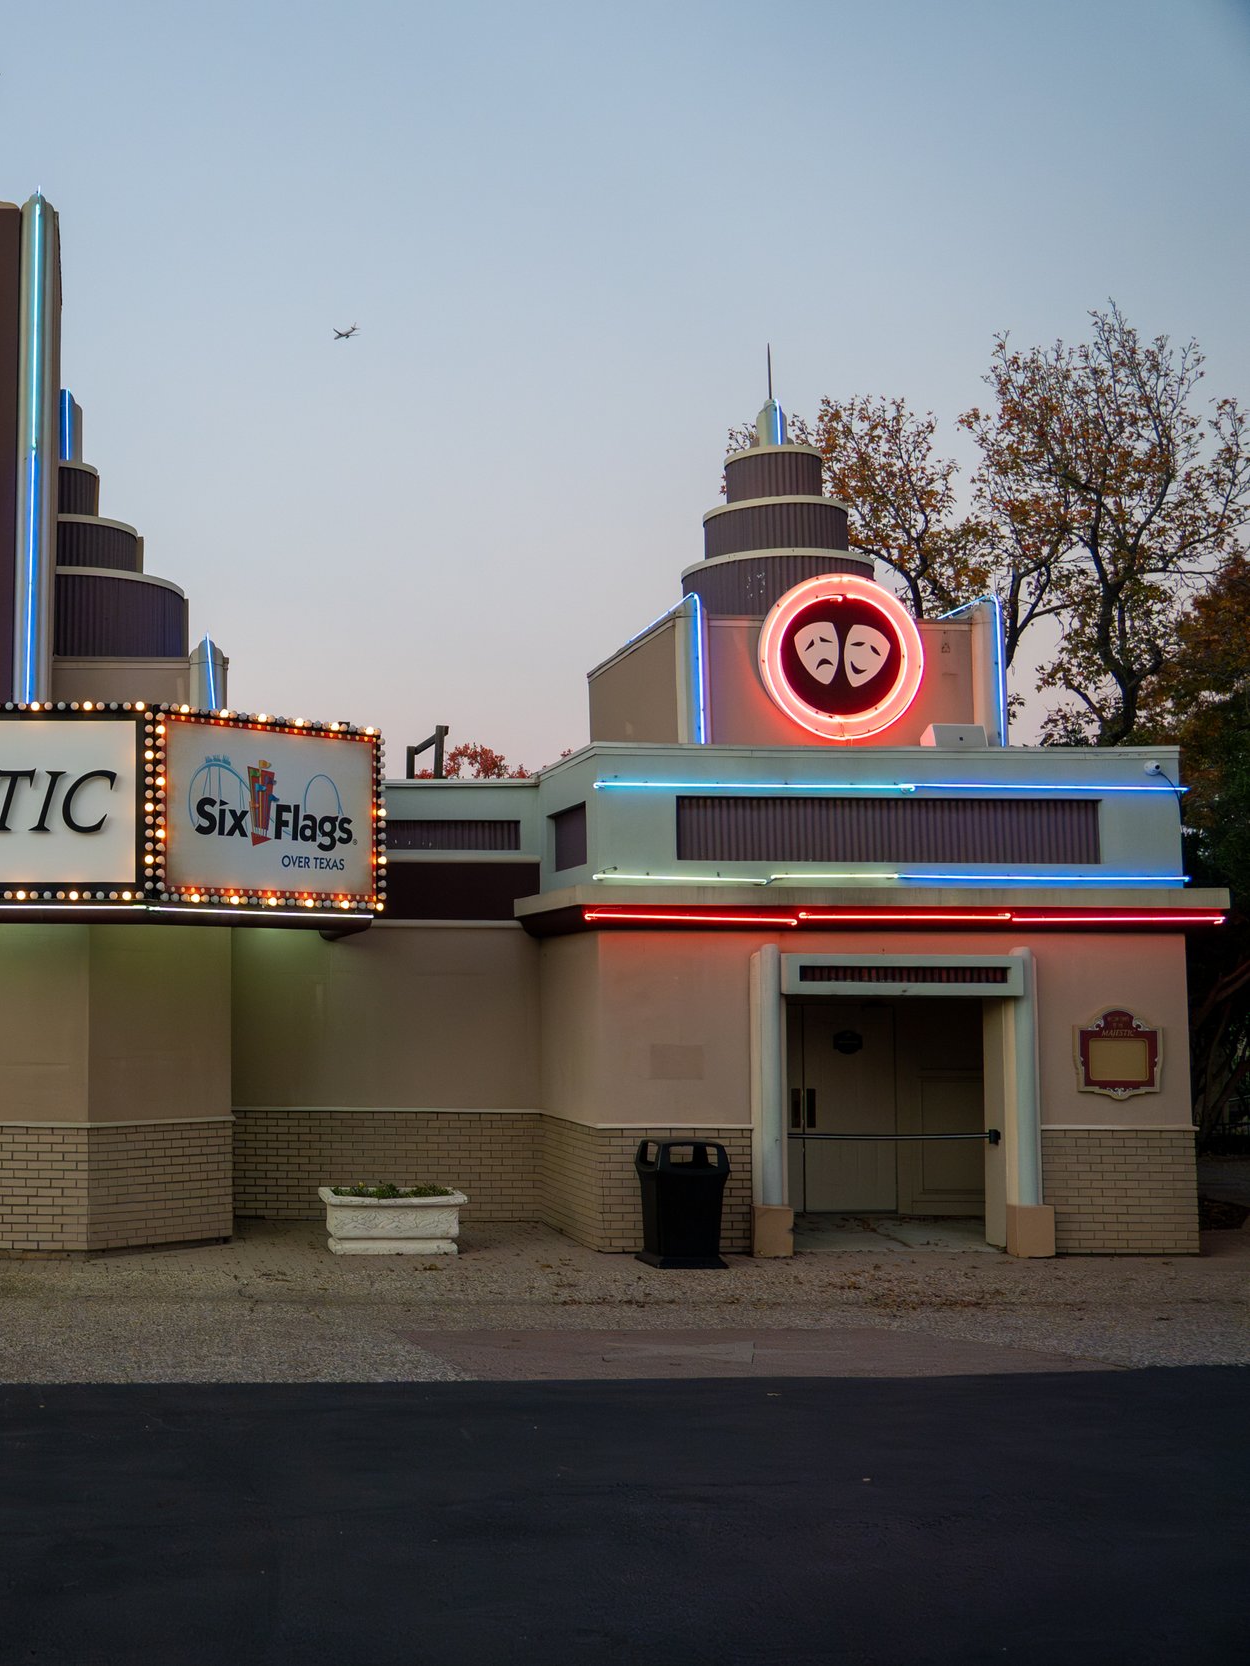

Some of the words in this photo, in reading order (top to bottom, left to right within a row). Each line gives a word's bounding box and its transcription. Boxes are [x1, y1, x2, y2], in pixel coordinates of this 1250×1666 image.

[195, 797, 250, 838] Six
[282, 855, 311, 868] OVER
[313, 857, 345, 871] TEXAS
[1101, 1029, 1135, 1037] MAJESTIC
